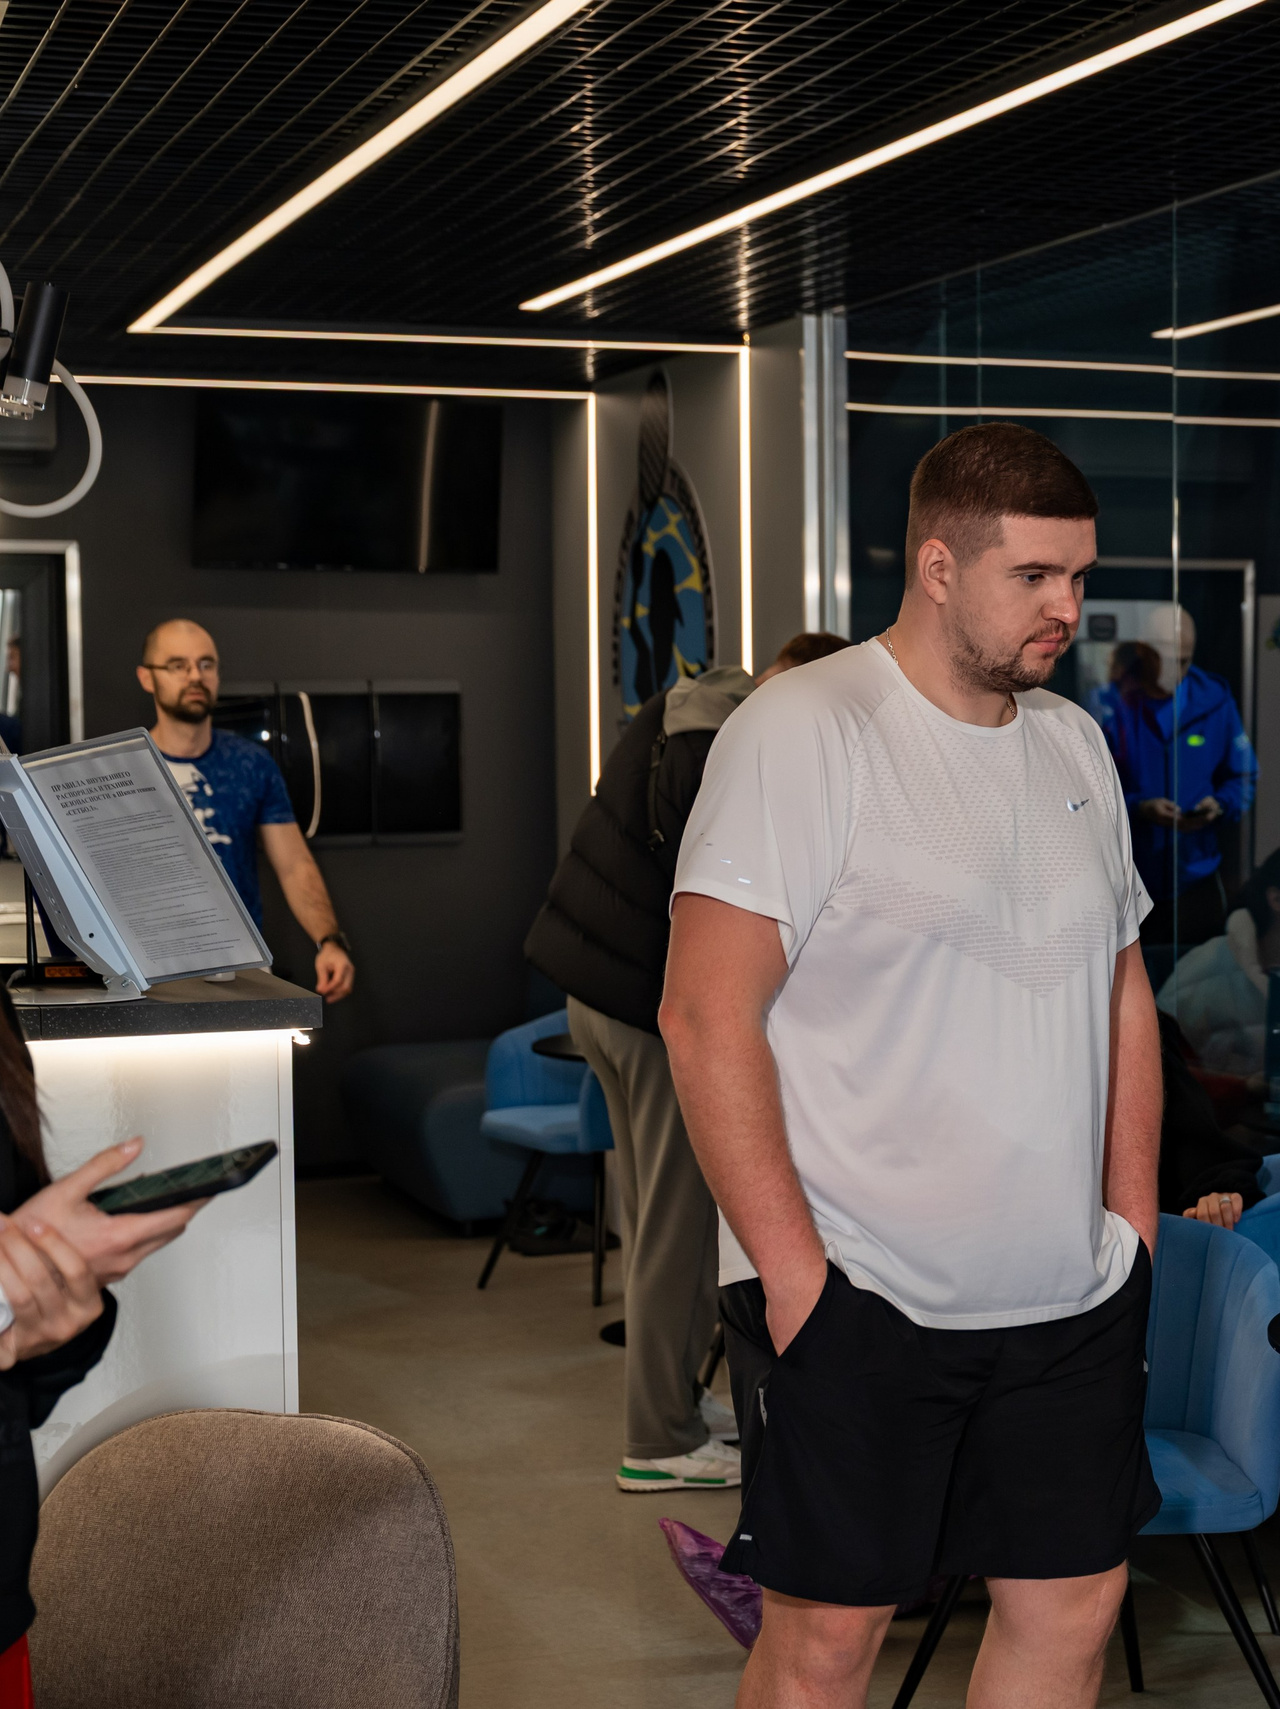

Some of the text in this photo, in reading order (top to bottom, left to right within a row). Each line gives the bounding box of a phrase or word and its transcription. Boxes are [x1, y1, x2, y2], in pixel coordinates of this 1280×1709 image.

[51, 771, 131, 792] ПРАВИЛА ВНУТРЕННЕГО
[56, 787, 98, 801] РАСПОРЯДКА
[103, 780, 134, 791] ТЕХНИКИ
[60, 793, 111, 809] БЕЗОПАСНОСТИ
